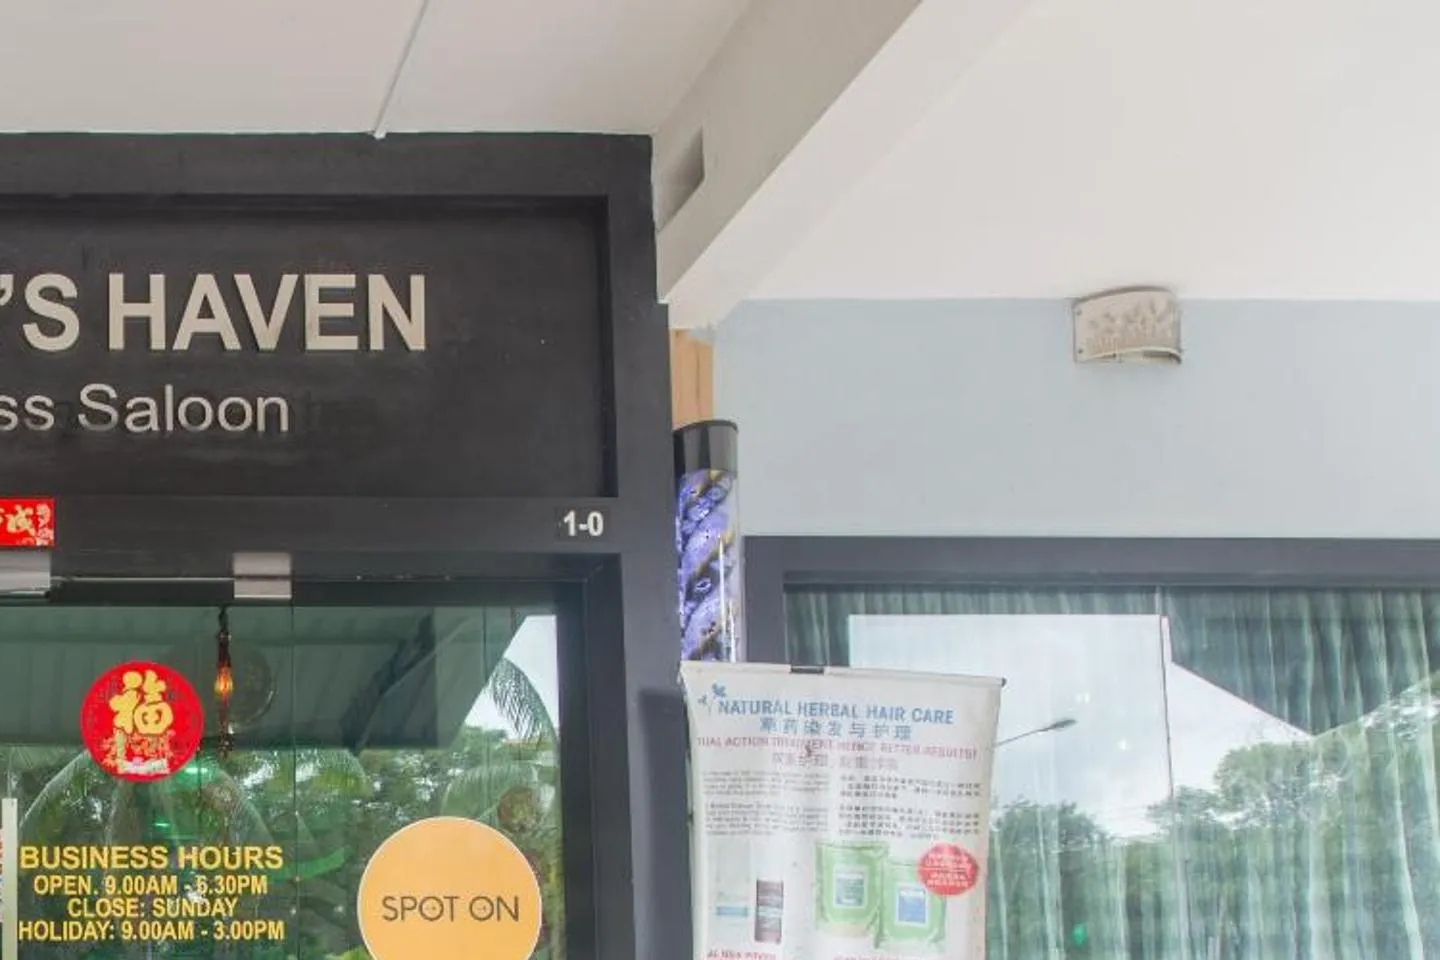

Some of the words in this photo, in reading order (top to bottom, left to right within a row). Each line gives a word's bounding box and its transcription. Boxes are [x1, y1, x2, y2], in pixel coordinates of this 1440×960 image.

[108, 273, 427, 351] HAVEN
[78, 383, 290, 434] Saloon
[563, 510, 604, 537] 1-0
[108, 669, 174, 735] 福
[717, 699, 792, 716] NATURAL
[798, 702, 858, 718] HERBAL
[866, 704, 906, 721] HAIR
[911, 707, 955, 724] CARE
[20, 846, 168, 869] BUSINESS
[178, 846, 284, 870] HOURS
[105, 875, 178, 894] 9.00AM
[196, 875, 268, 895] 6.30PM
[68, 898, 145, 918] CLOSE:
[152, 898, 238, 918] SUNDAY
[381, 895, 460, 922] SPOT
[469, 895, 520, 922] ON
[19, 920, 115, 940] HOLIDAY:
[121, 920, 194, 940] 9.00AM
[213, 920, 286, 940] 3.00PM
